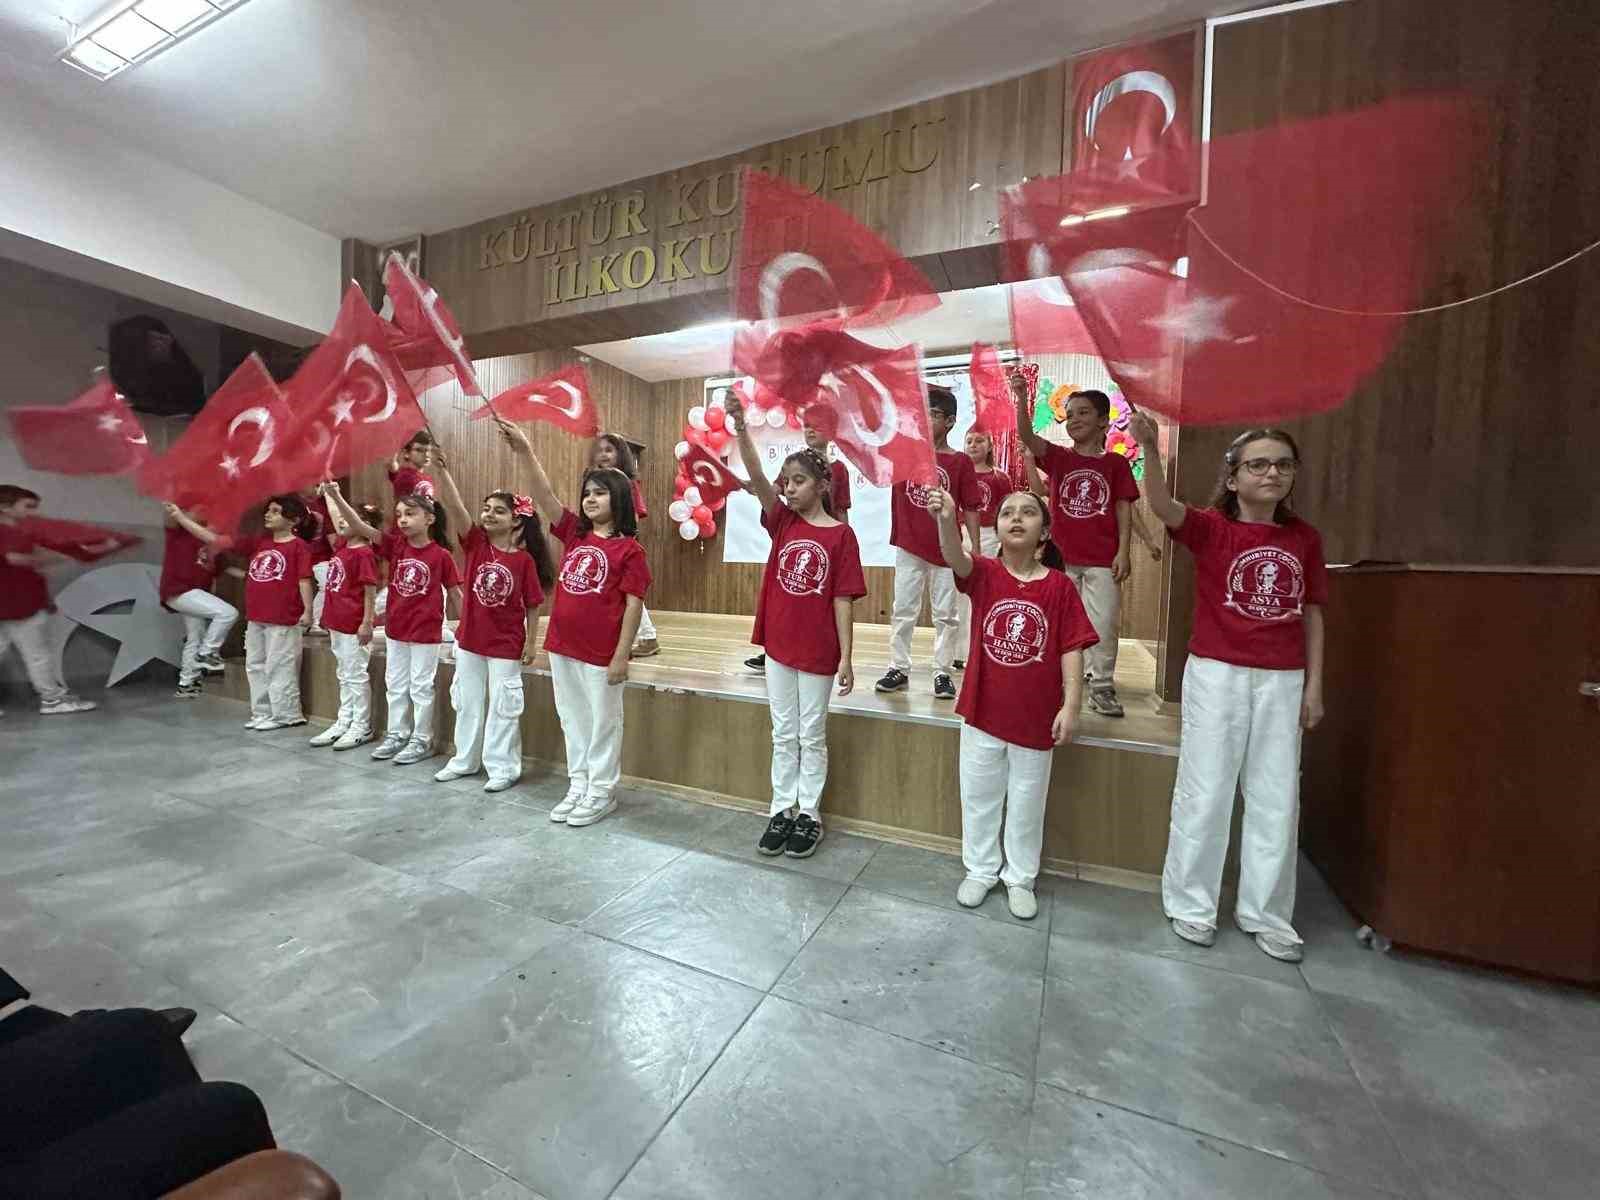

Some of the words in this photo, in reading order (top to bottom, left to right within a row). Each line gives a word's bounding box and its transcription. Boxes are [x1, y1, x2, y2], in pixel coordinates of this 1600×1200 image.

[479, 190, 649, 271] KÜLTÜR
[1250, 595, 1281, 606] ASYA
[993, 639, 1030, 654] HANNE
